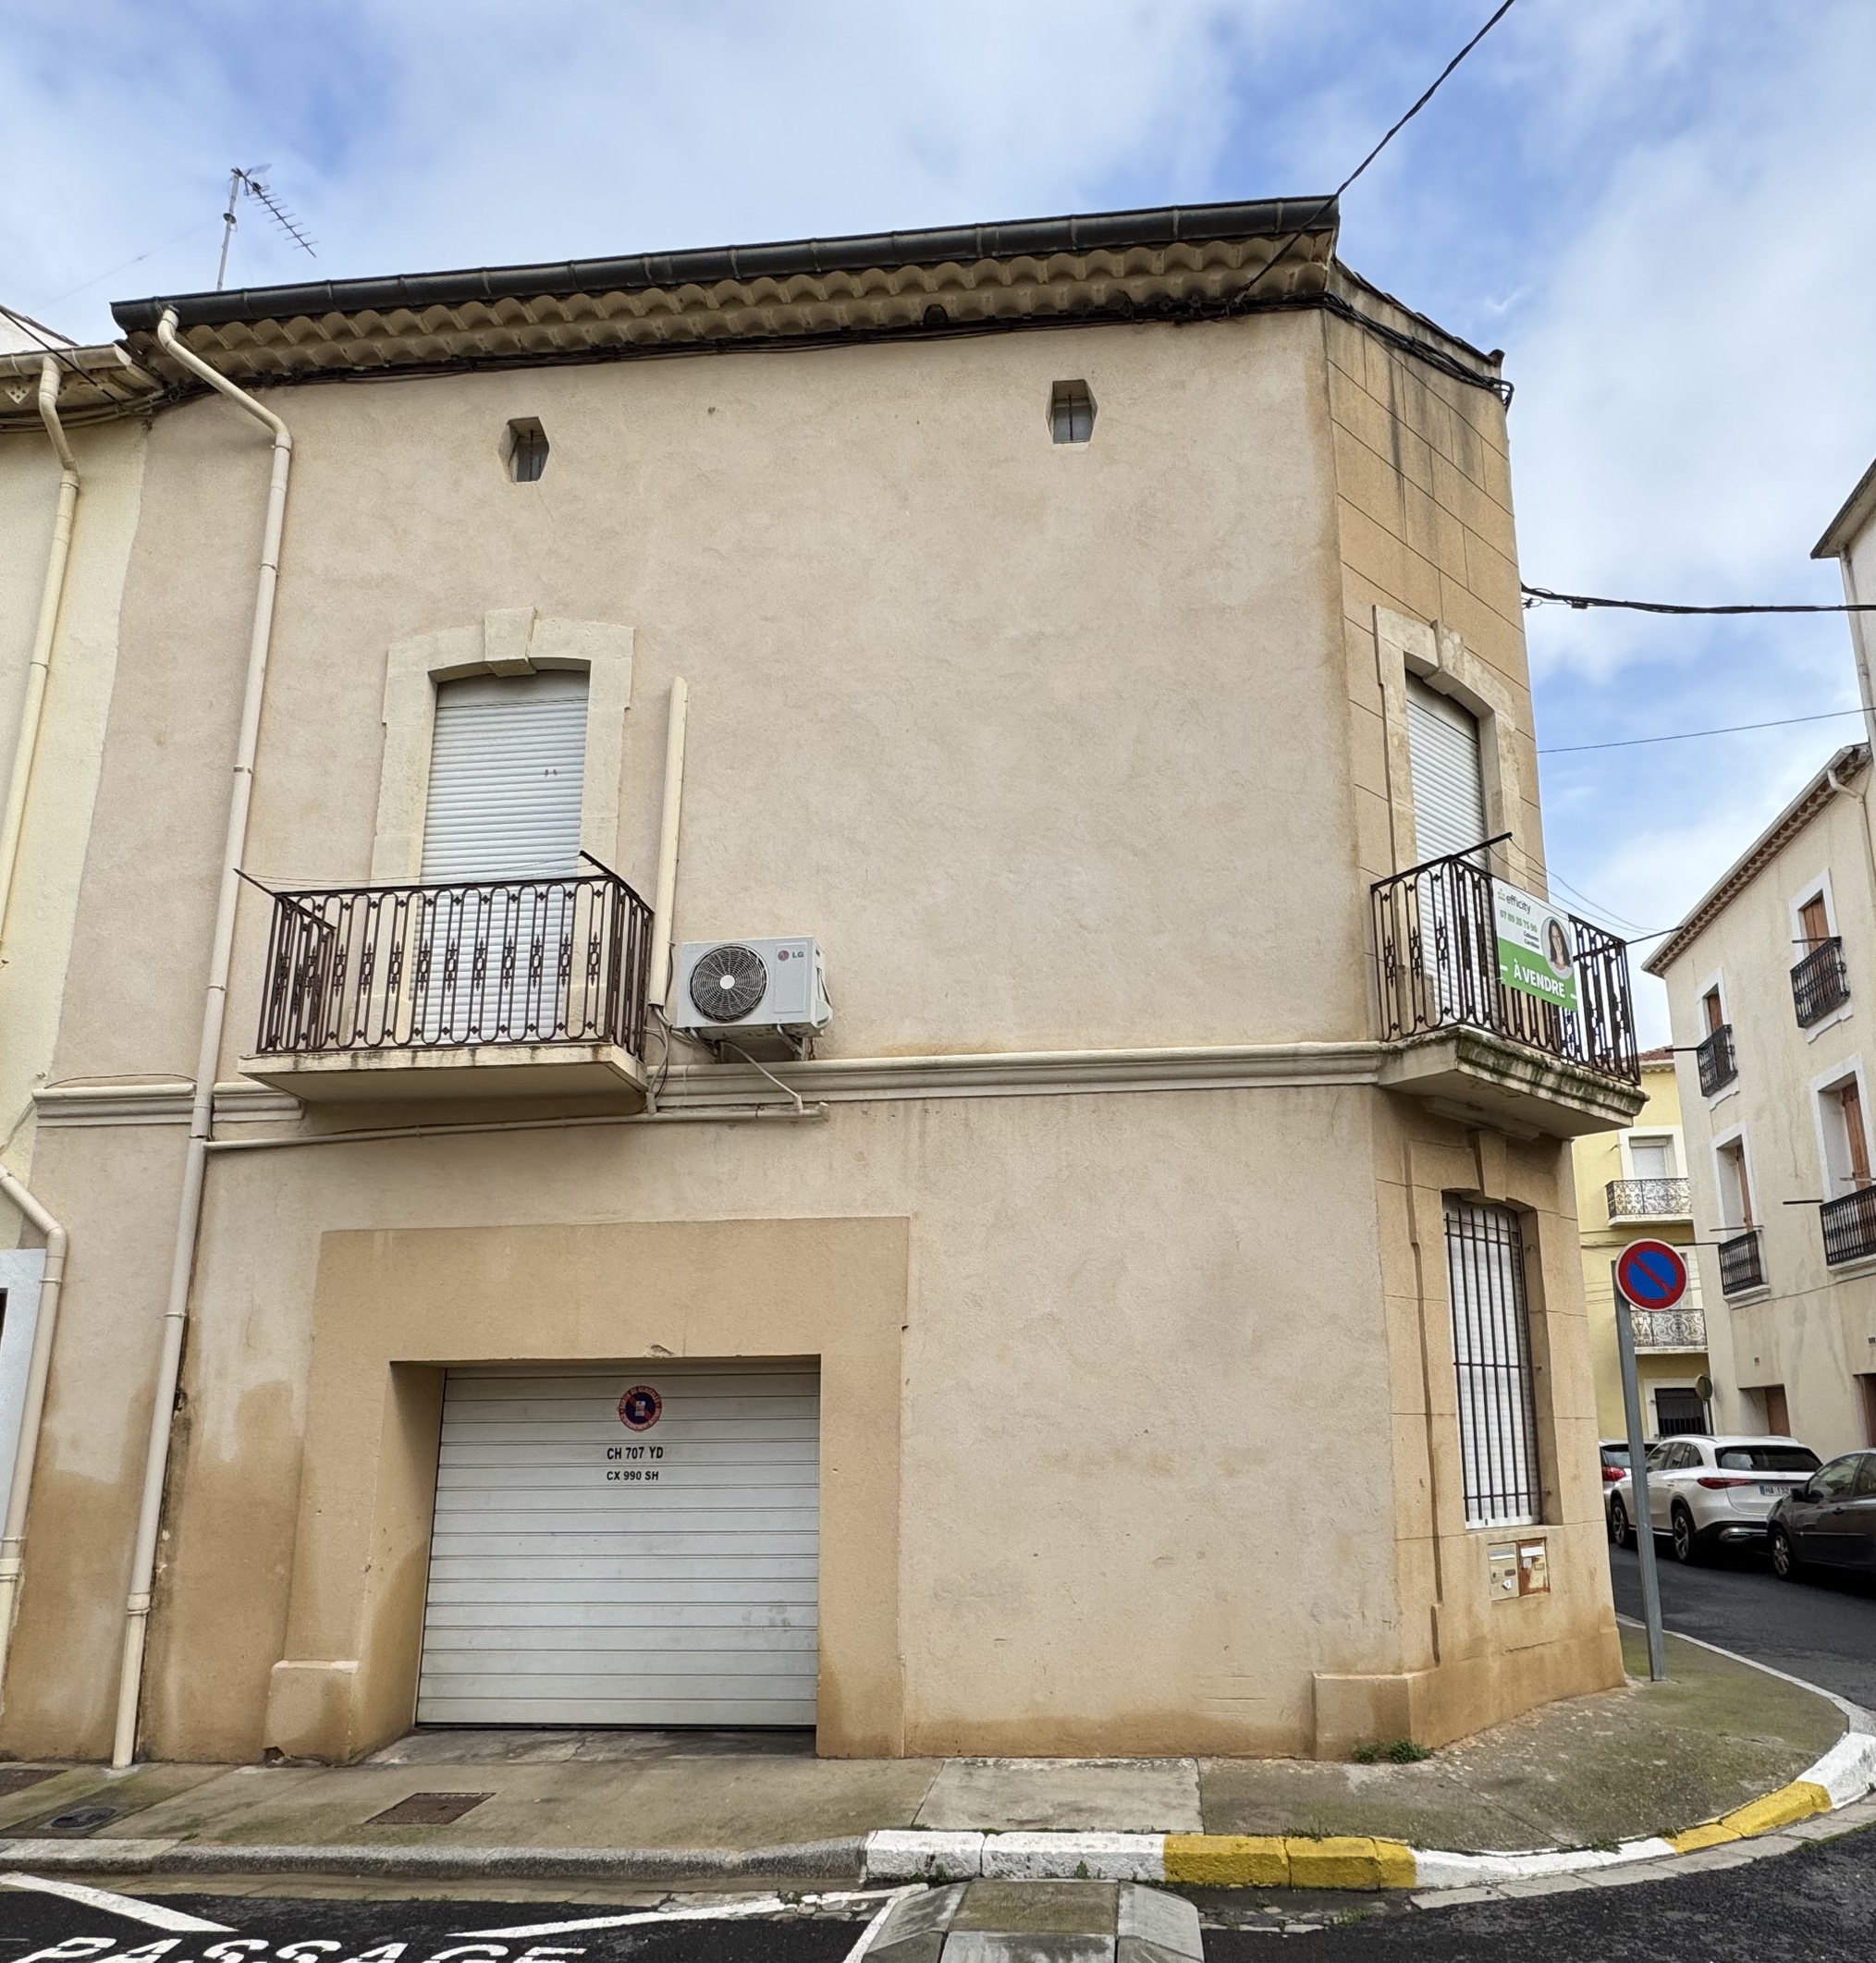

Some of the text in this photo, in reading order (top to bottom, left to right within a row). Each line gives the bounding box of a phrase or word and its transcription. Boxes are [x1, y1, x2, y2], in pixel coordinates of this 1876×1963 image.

[1506, 895, 1531, 914] efficity
[1514, 958, 1565, 999] À VENDRE
[607, 1447, 664, 1459] CH 707 YD
[607, 1471, 659, 1480] CX 990 SH
